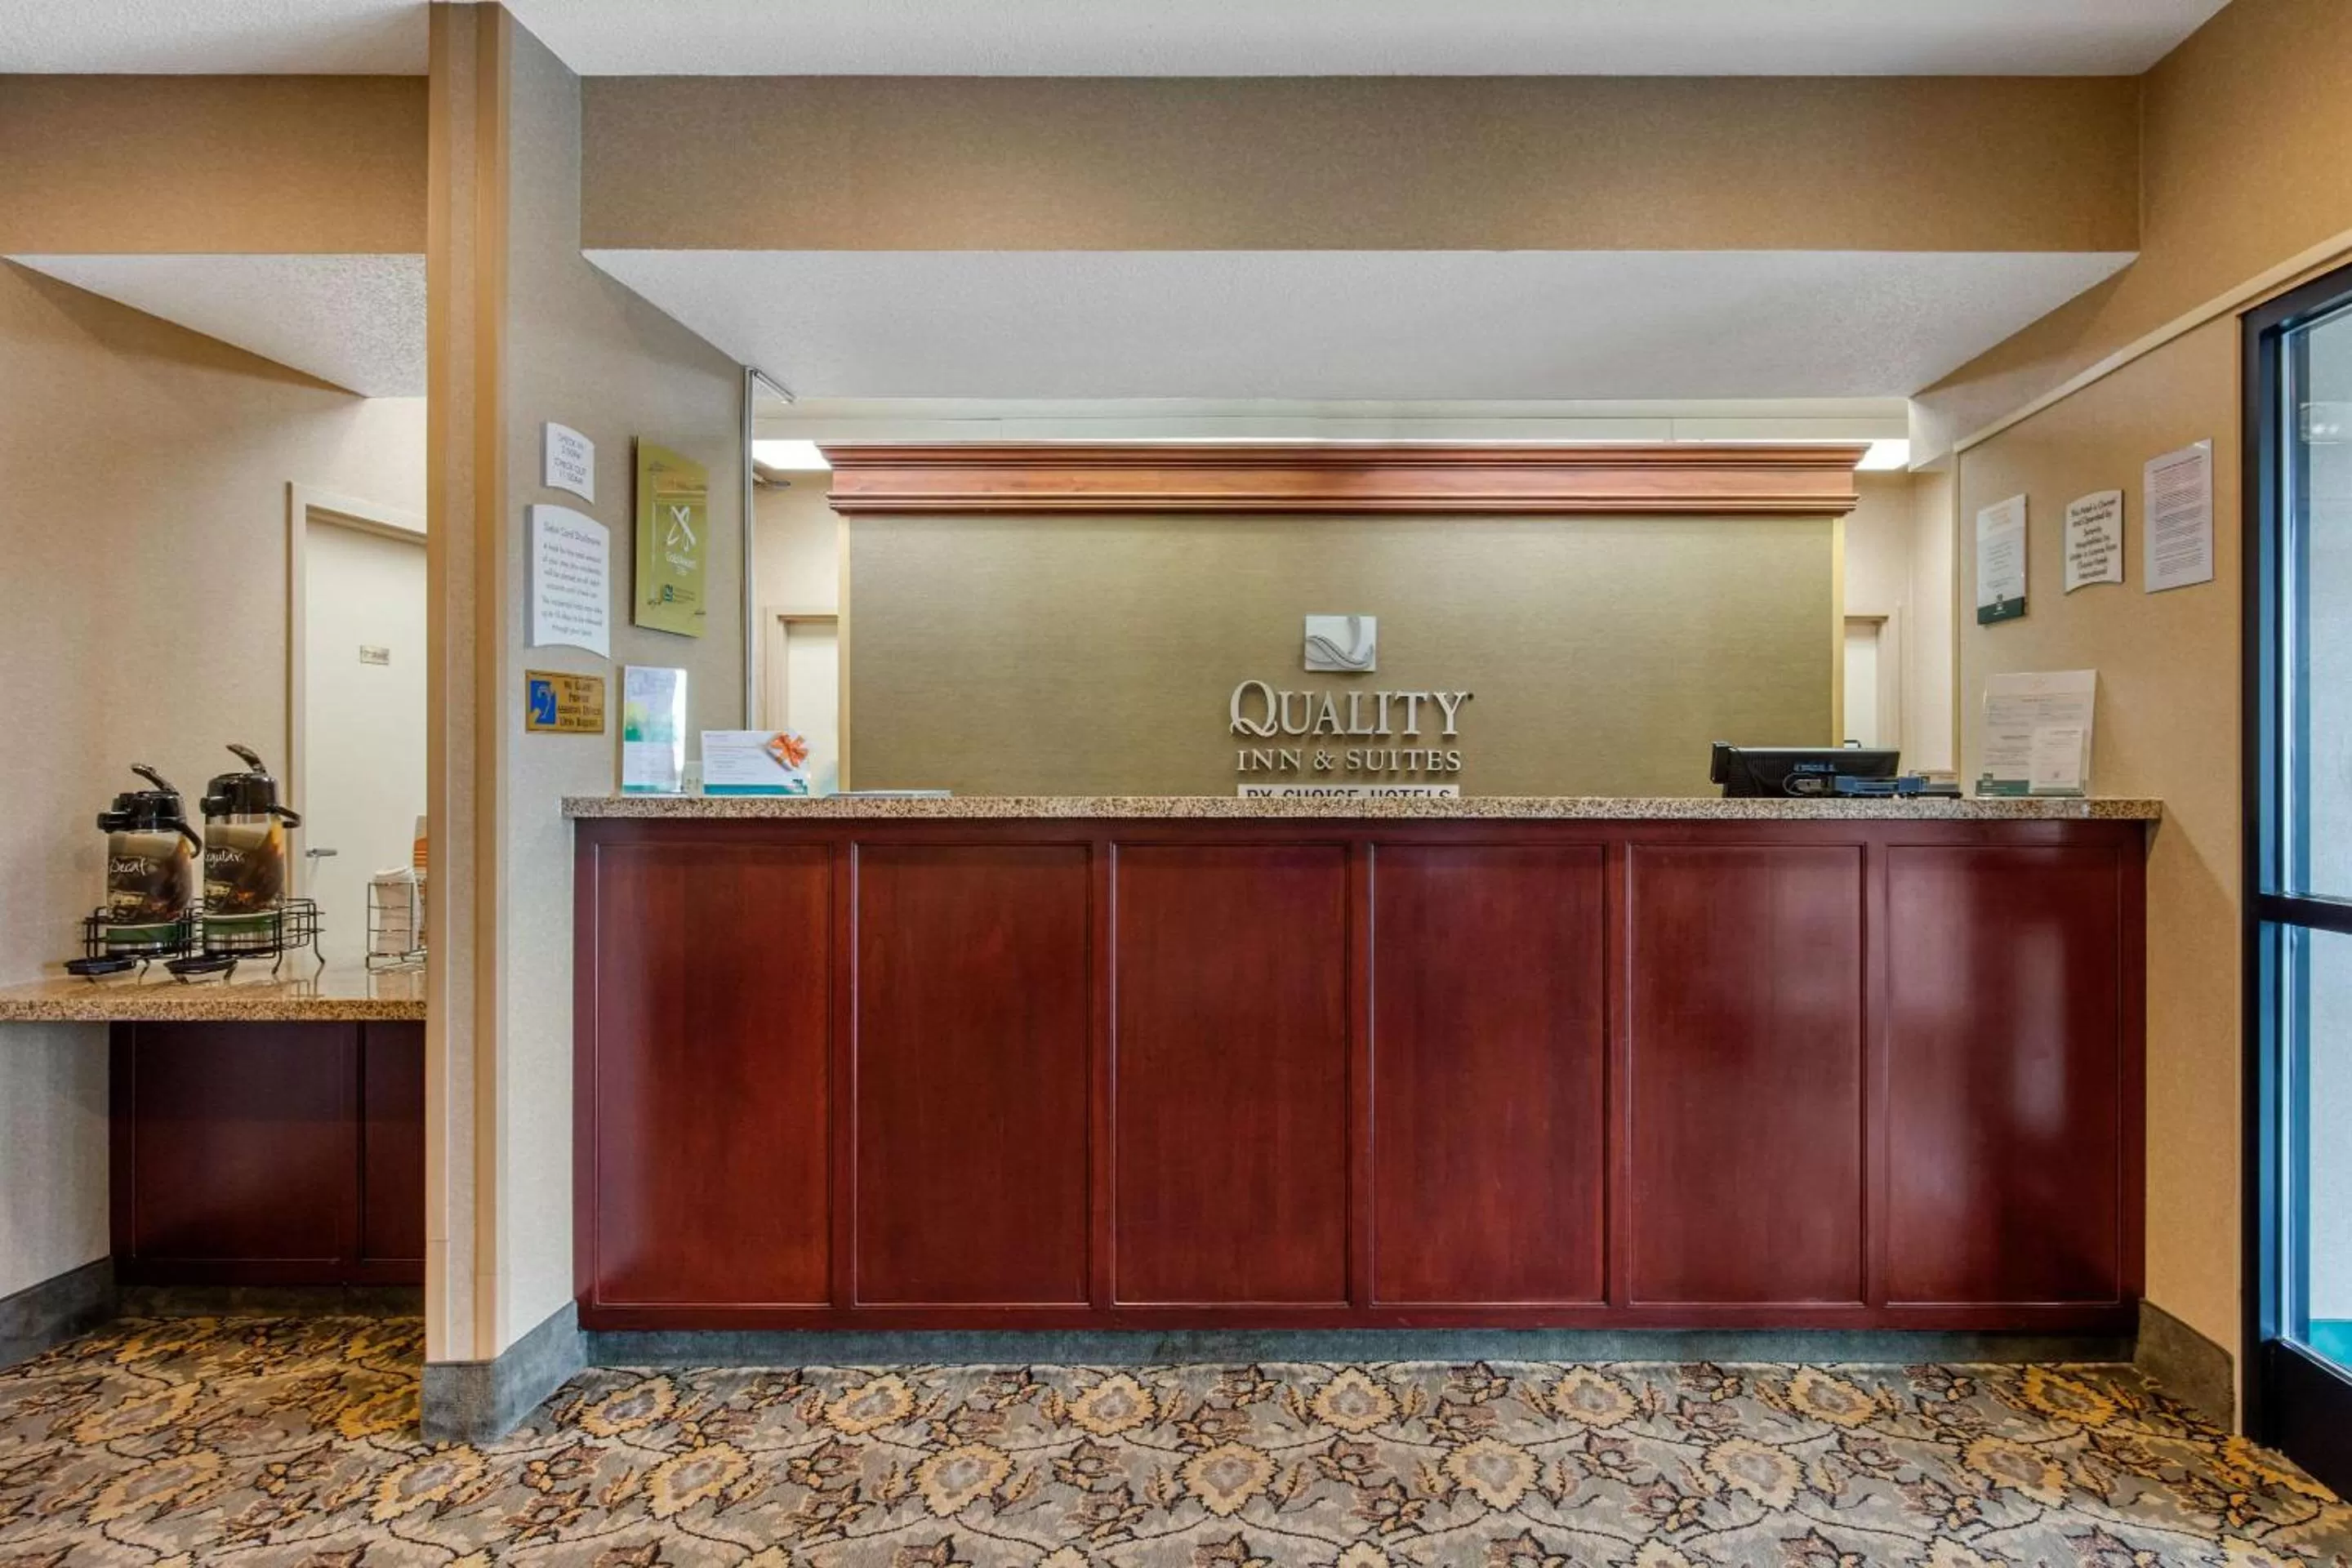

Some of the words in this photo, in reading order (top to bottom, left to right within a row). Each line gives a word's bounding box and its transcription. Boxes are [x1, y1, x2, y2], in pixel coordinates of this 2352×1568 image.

[1229, 679, 1468, 737] QUALITY
[1236, 749, 1302, 771] INN
[1313, 750, 1336, 770] &
[1347, 749, 1462, 772] SUITES
[204, 849, 244, 869] egular
